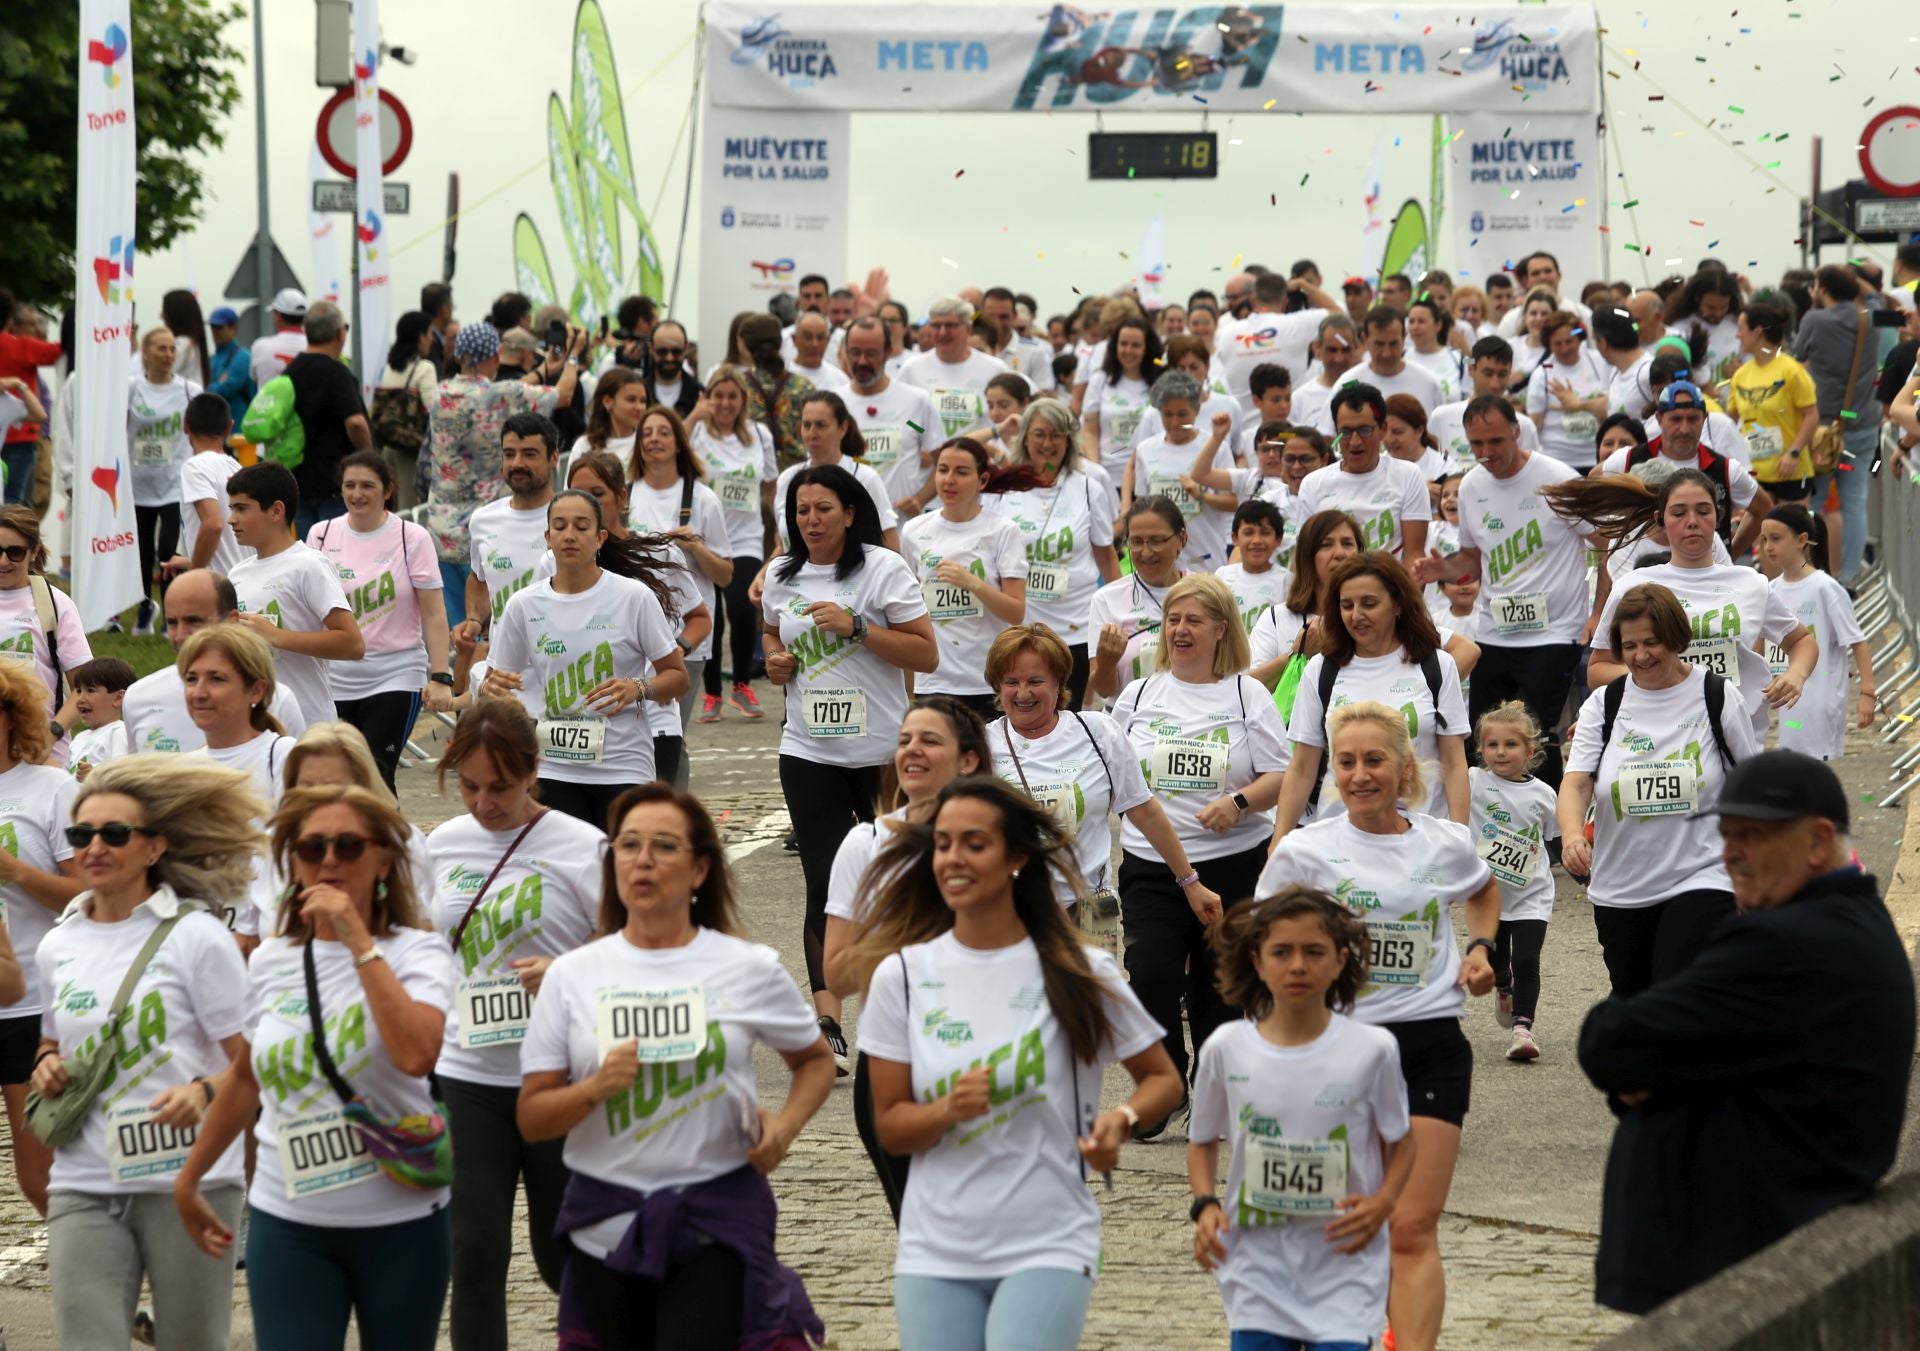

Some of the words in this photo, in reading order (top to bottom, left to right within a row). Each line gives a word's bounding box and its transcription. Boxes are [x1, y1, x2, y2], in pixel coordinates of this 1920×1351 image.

[773, 40, 828, 50] CARRERA
[876, 41, 999, 71] META
[1314, 43, 1425, 74] META
[768, 53, 837, 78] HUCA
[1500, 56, 1569, 81] HUCA
[723, 165, 753, 180] POR
[758, 166, 776, 180] LA
[782, 165, 829, 181] SALUD
[1470, 170, 1500, 184] POR
[1506, 169, 1524, 182] LA
[723, 483, 750, 502] 1262
[1488, 518, 1544, 586] HUCA
[493, 560, 513, 570] HUCA
[936, 589, 971, 607] 2146
[1502, 604, 1536, 623] 1236
[544, 645, 567, 657] HUCA
[1696, 640, 1714, 648] HUCA
[545, 640, 614, 718] HUCA
[813, 702, 853, 724] 1707
[550, 727, 591, 750] 1075
[1188, 740, 1205, 748] HUCA
[1630, 741, 1655, 752] HUCA
[1168, 752, 1212, 778] 1638
[1653, 762, 1672, 770] HUCA
[1031, 784, 1050, 793] HUCA
[1636, 775, 1681, 801] 1759
[1652, 804, 1663, 812] POR
[1491, 812, 1513, 824] HUCA
[1513, 833, 1527, 846] HUCA
[1486, 840, 1529, 874] 2341
[1346, 896, 1383, 910] HUCA
[450, 872, 542, 978] HUCA
[1384, 921, 1406, 932] HUCA
[500, 975, 520, 986] HUCA
[65, 997, 98, 1011] HUCA
[613, 1002, 690, 1039] 0000
[936, 1029, 974, 1042] HUCA
[1248, 1122, 1283, 1138] HUCA
[1262, 1159, 1324, 1194] 1545
